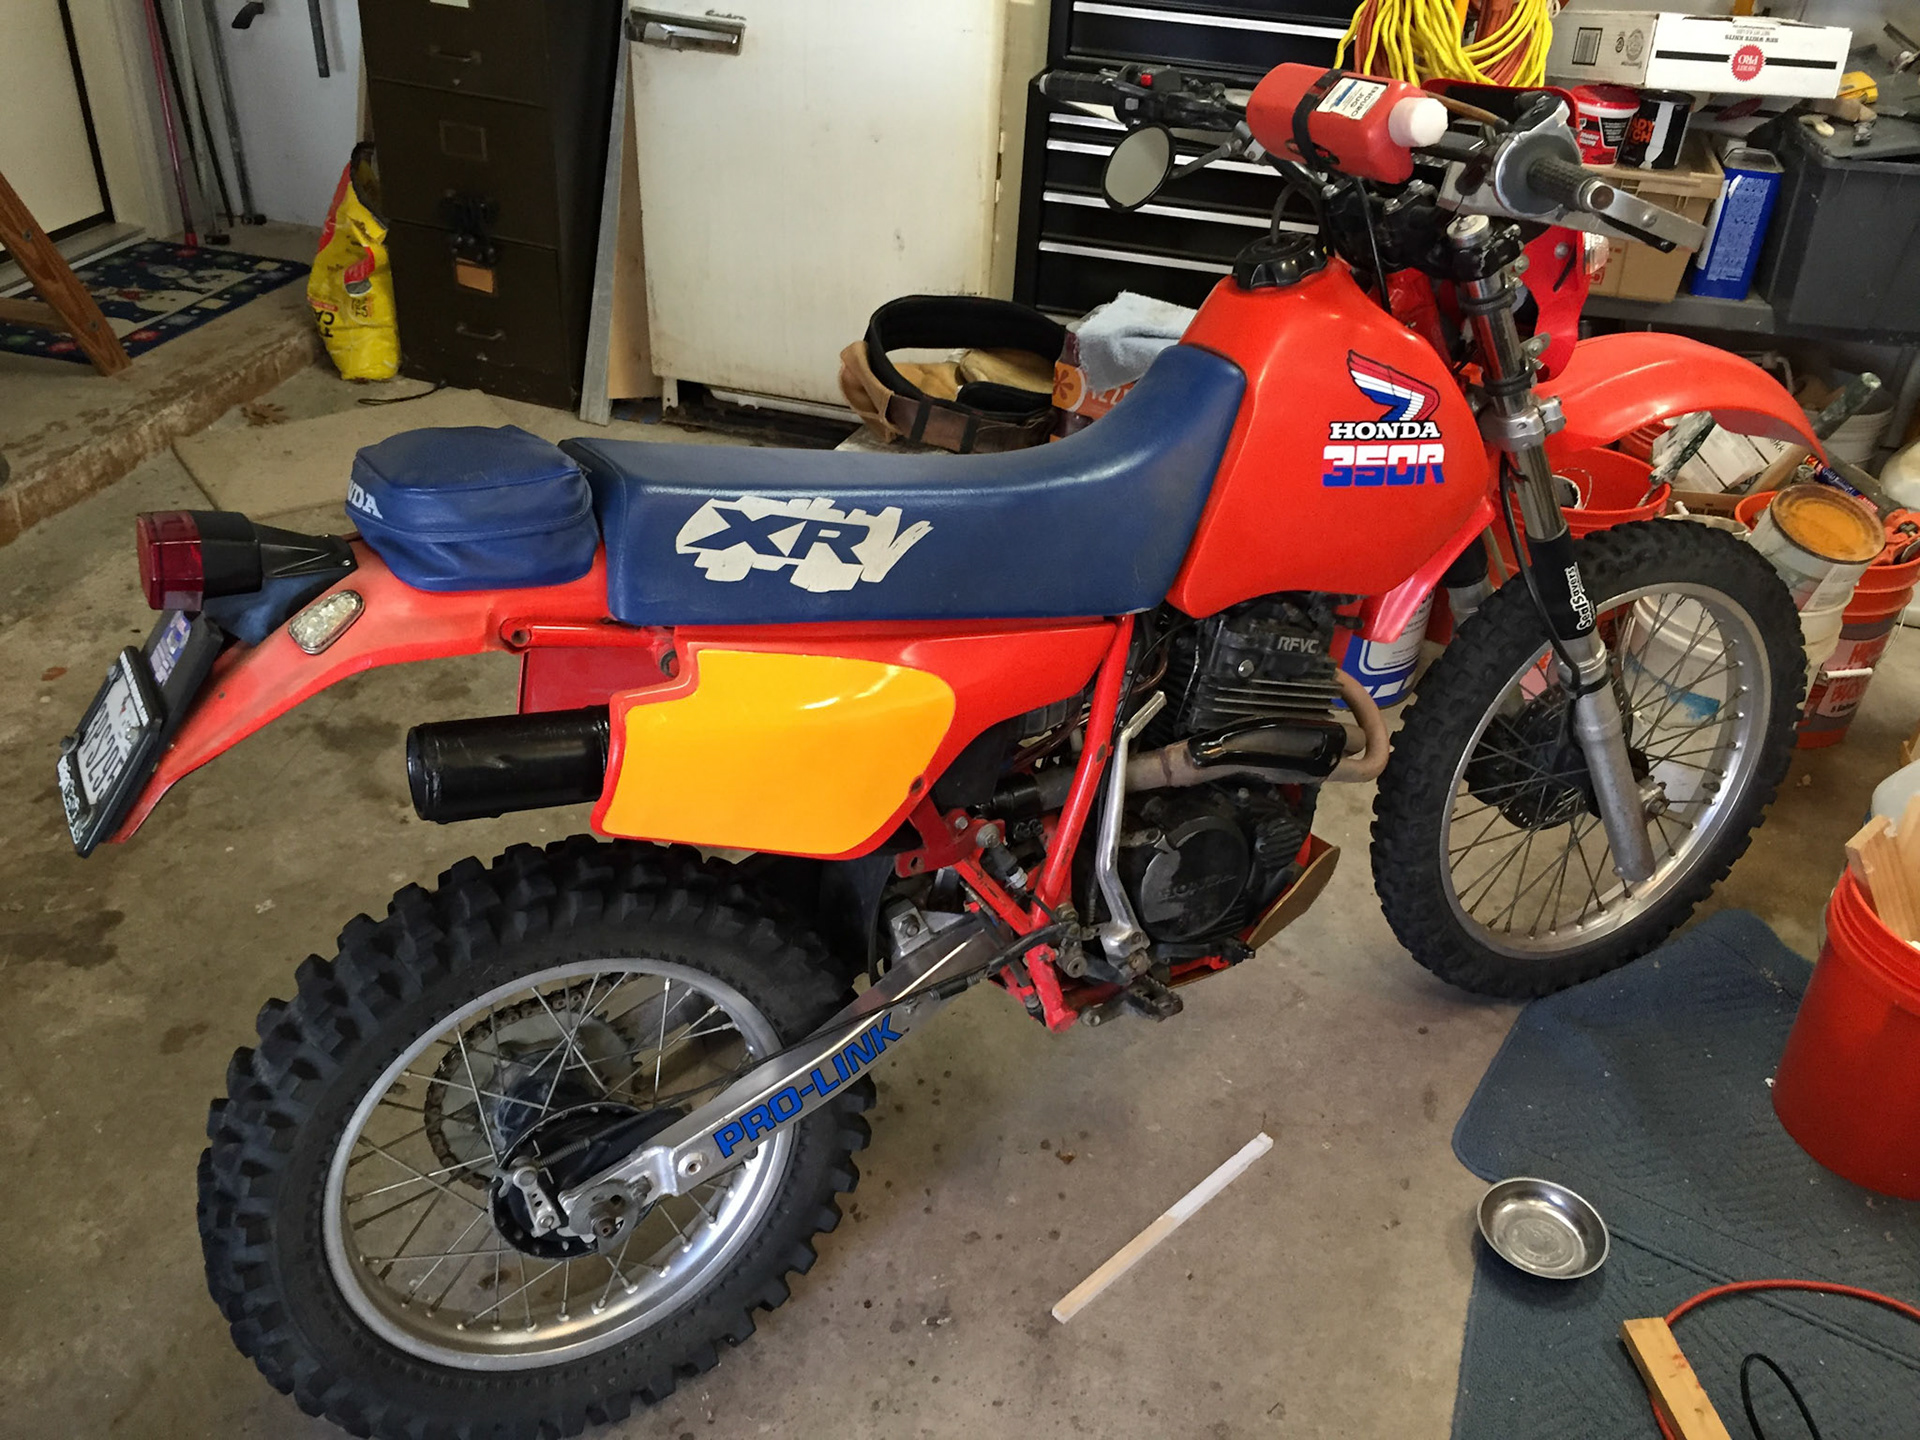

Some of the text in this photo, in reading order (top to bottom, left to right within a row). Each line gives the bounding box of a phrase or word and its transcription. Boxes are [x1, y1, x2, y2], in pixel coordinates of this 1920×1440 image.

[1738, 54, 1759, 66] PRO
[1329, 421, 1441, 440] HONDA
[1323, 443, 1445, 487] 350R
[684, 506, 868, 566] XR
[1276, 636, 1320, 654] RFVC
[712, 1011, 904, 1159] PRO-LINK
